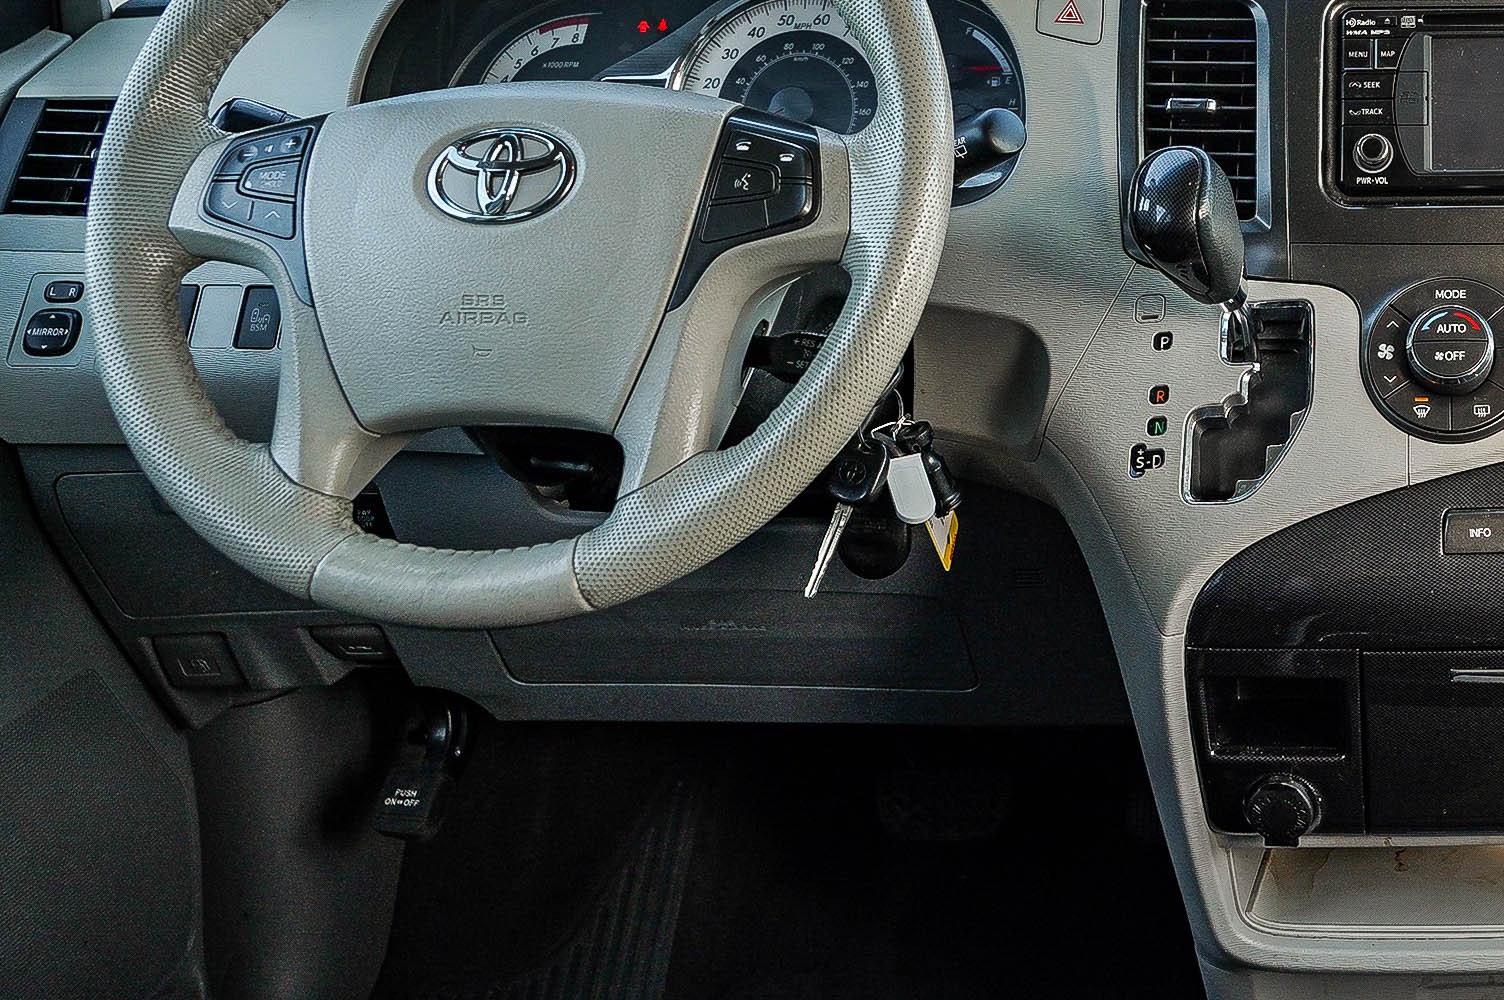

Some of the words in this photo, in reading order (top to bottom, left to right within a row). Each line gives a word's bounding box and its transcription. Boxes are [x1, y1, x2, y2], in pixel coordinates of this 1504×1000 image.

[777, 14, 795, 26] 50
[813, 13, 831, 26] 60
[794, 22, 812, 30] MPH
[747, 26, 765, 38] 40
[551, 37, 560, 48] 7
[571, 33, 580, 43] 8
[530, 46, 539, 56] 6
[721, 48, 739, 60] 30
[513, 58, 523, 69] 5
[755, 55, 766, 63] 60
[841, 57, 854, 65] 120
[703, 78, 720, 89] 20
[735, 77, 746, 85] 40
[856, 81, 869, 89] 140
[1005, 77, 1012, 85] E
[1009, 98, 1016, 106] H
[858, 108, 871, 116] 160
[953, 136, 967, 146] EAR
[260, 171, 287, 180] MODE
[50, 287, 56, 296] L
[68, 287, 76, 297] R
[1435, 289, 1466, 299] MODE
[440, 311, 528, 325] AIRBAG
[32, 327, 65, 336] MIRROR
[1436, 323, 1467, 333] AUTO
[1160, 336, 1170, 349] P
[1444, 351, 1466, 361] OFF
[1156, 390, 1165, 403] R
[1154, 422, 1165, 434] N
[1469, 527, 1491, 538] INFO
[395, 788, 418, 798] PUSH
[403, 799, 420, 807] OFF
